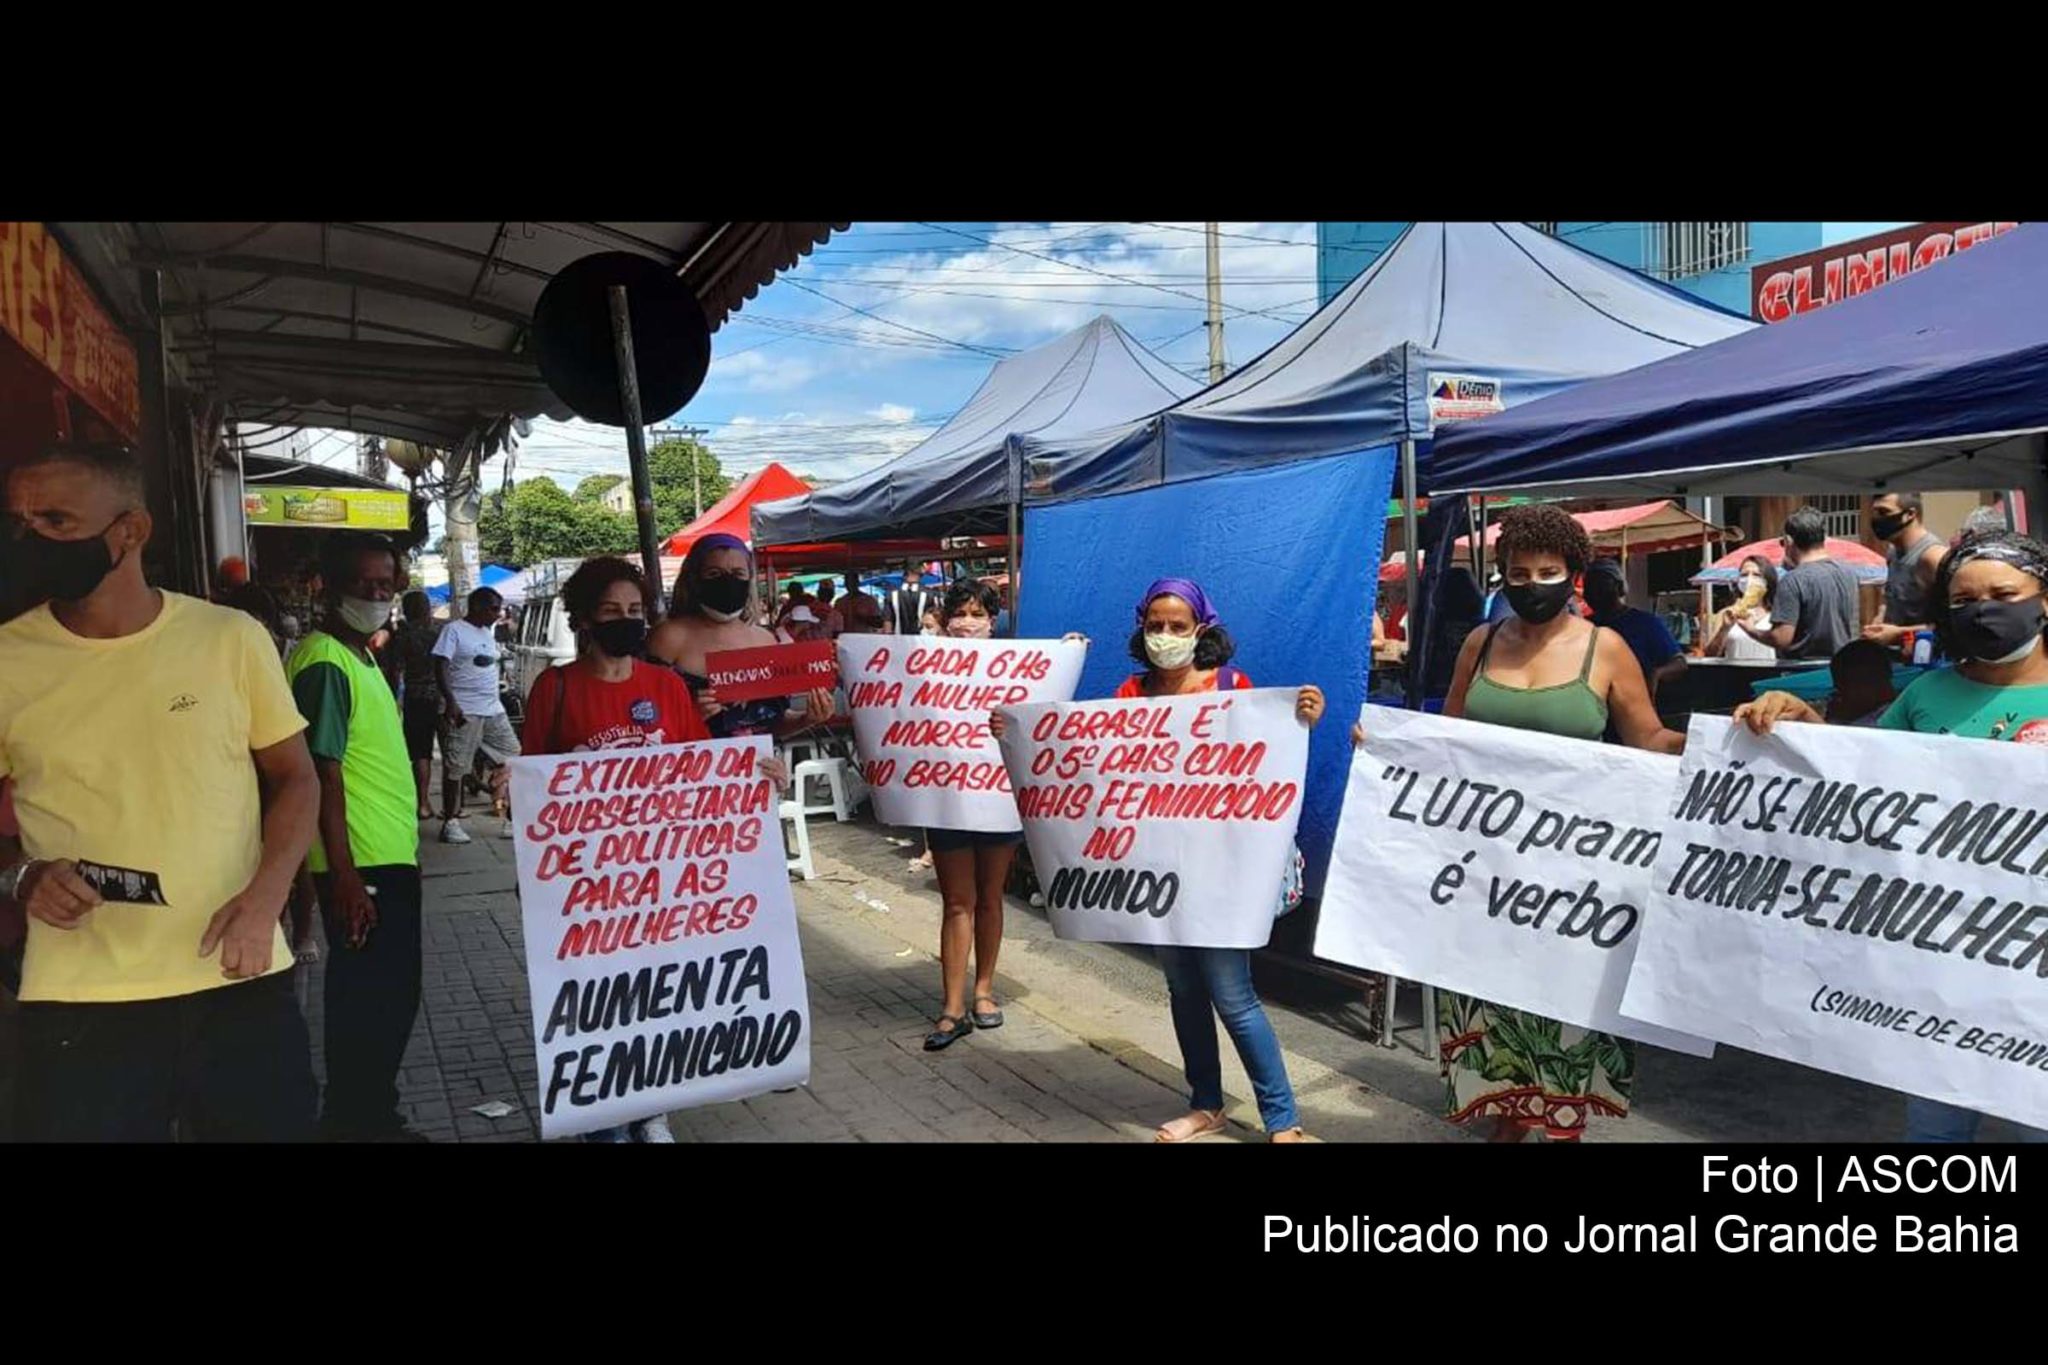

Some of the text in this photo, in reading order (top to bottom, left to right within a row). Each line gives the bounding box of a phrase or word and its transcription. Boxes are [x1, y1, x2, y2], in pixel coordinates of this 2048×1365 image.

[865, 648, 891, 674] A
[905, 648, 979, 677] CADA
[850, 681, 903, 709] UMA
[881, 719, 990, 749] MORRE
[1032, 711, 1058, 742] O
[1057, 706, 1174, 742] BRASIL
[547, 744, 758, 797] EXTINÇÃO DA
[864, 758, 1014, 793] NO BRASIL
[1031, 746, 1055, 777] O
[1183, 741, 1268, 777] COM
[526, 779, 771, 843] SUBSECRETARIA
[1017, 781, 1095, 819] MAIS
[1674, 759, 2048, 878] NÃO SE NASCE MUL
[536, 817, 763, 881] DE POLÍTICAS
[1082, 825, 1136, 861] NO
[561, 858, 729, 917] PARA AS
[1048, 865, 1181, 919] MUNDO
[1430, 850, 1640, 949] é verbo
[1666, 842, 1851, 929] TORNA-SE
[557, 893, 758, 960] MULHERES
[542, 945, 771, 1045] AUMENTA
[1810, 984, 1917, 1034] (SIMONE
[1914, 1015, 1961, 1046] DE
[544, 1004, 803, 1115] FEMINICÍDIO
